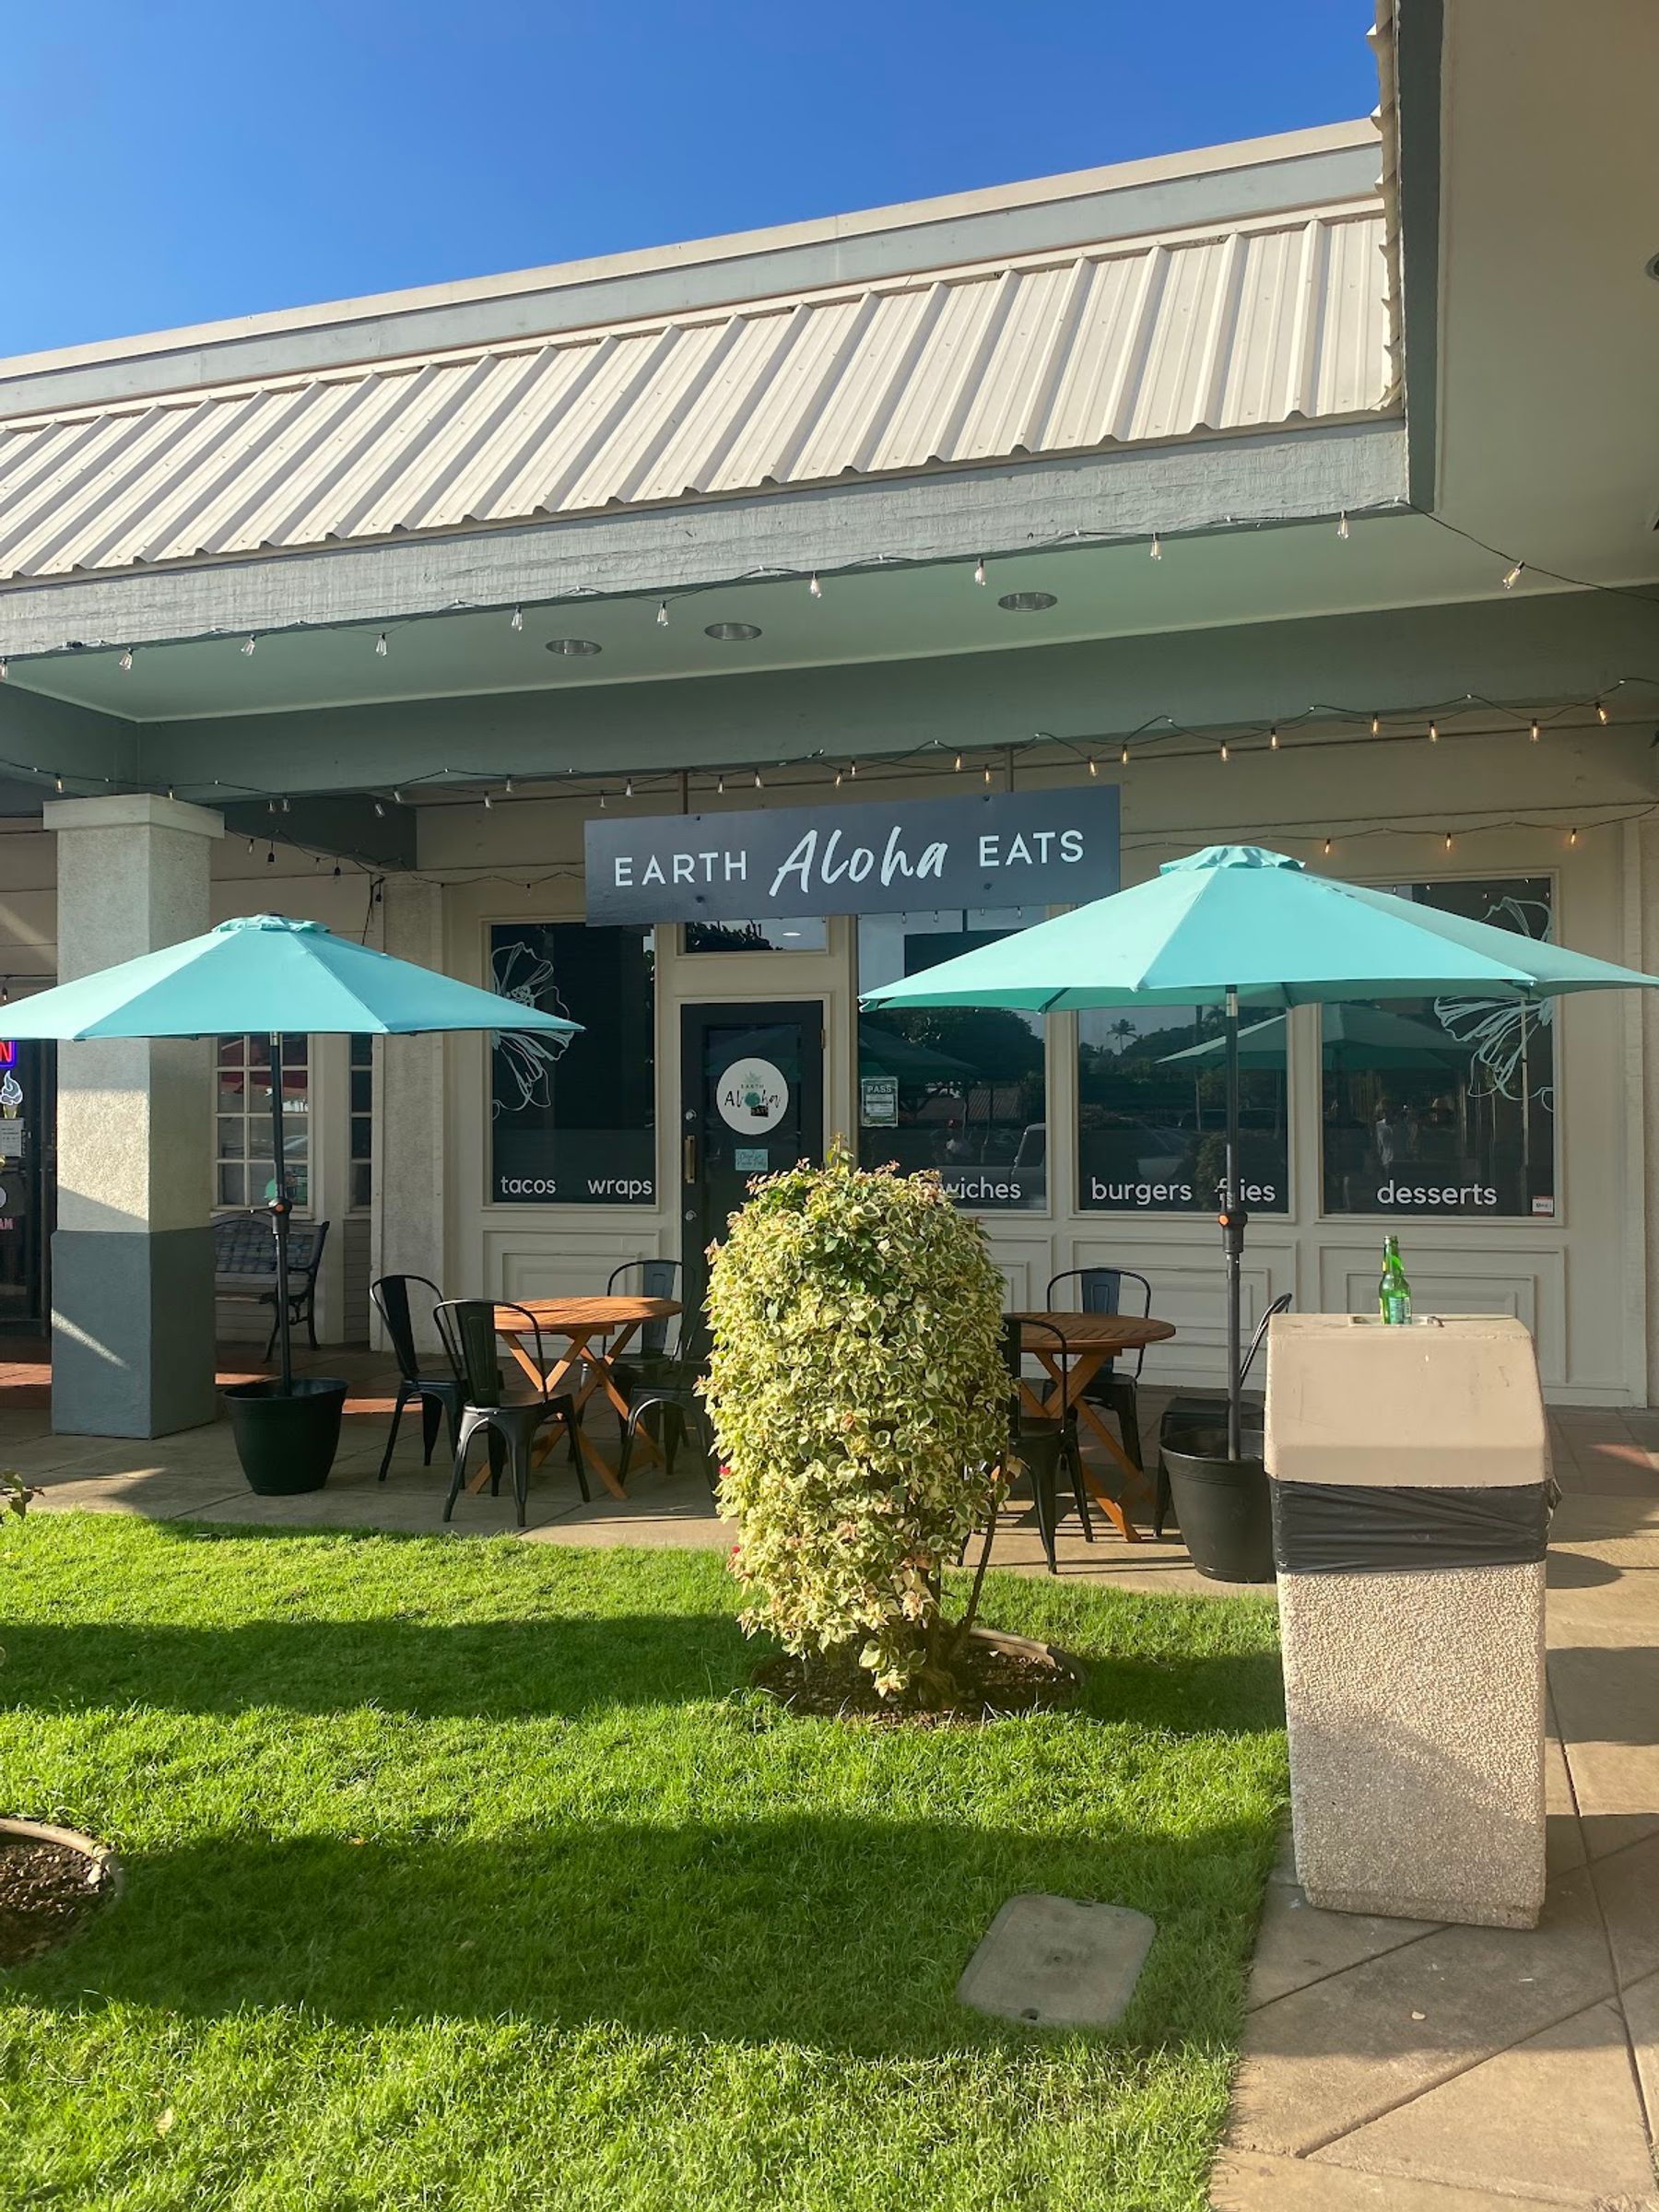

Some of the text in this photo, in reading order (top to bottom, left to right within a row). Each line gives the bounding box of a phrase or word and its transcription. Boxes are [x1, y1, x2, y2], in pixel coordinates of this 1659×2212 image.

[615, 826, 1085, 898] EARTH Aloha EATS
[866, 1084, 892, 1094] PASS
[500, 1175, 557, 1194] tacos
[587, 1179, 653, 1200] wraps
[939, 1176, 1022, 1199] wiches
[1091, 1176, 1193, 1206] burgers
[1216, 1177, 1277, 1202] fies
[1376, 1179, 1498, 1205] desserts
